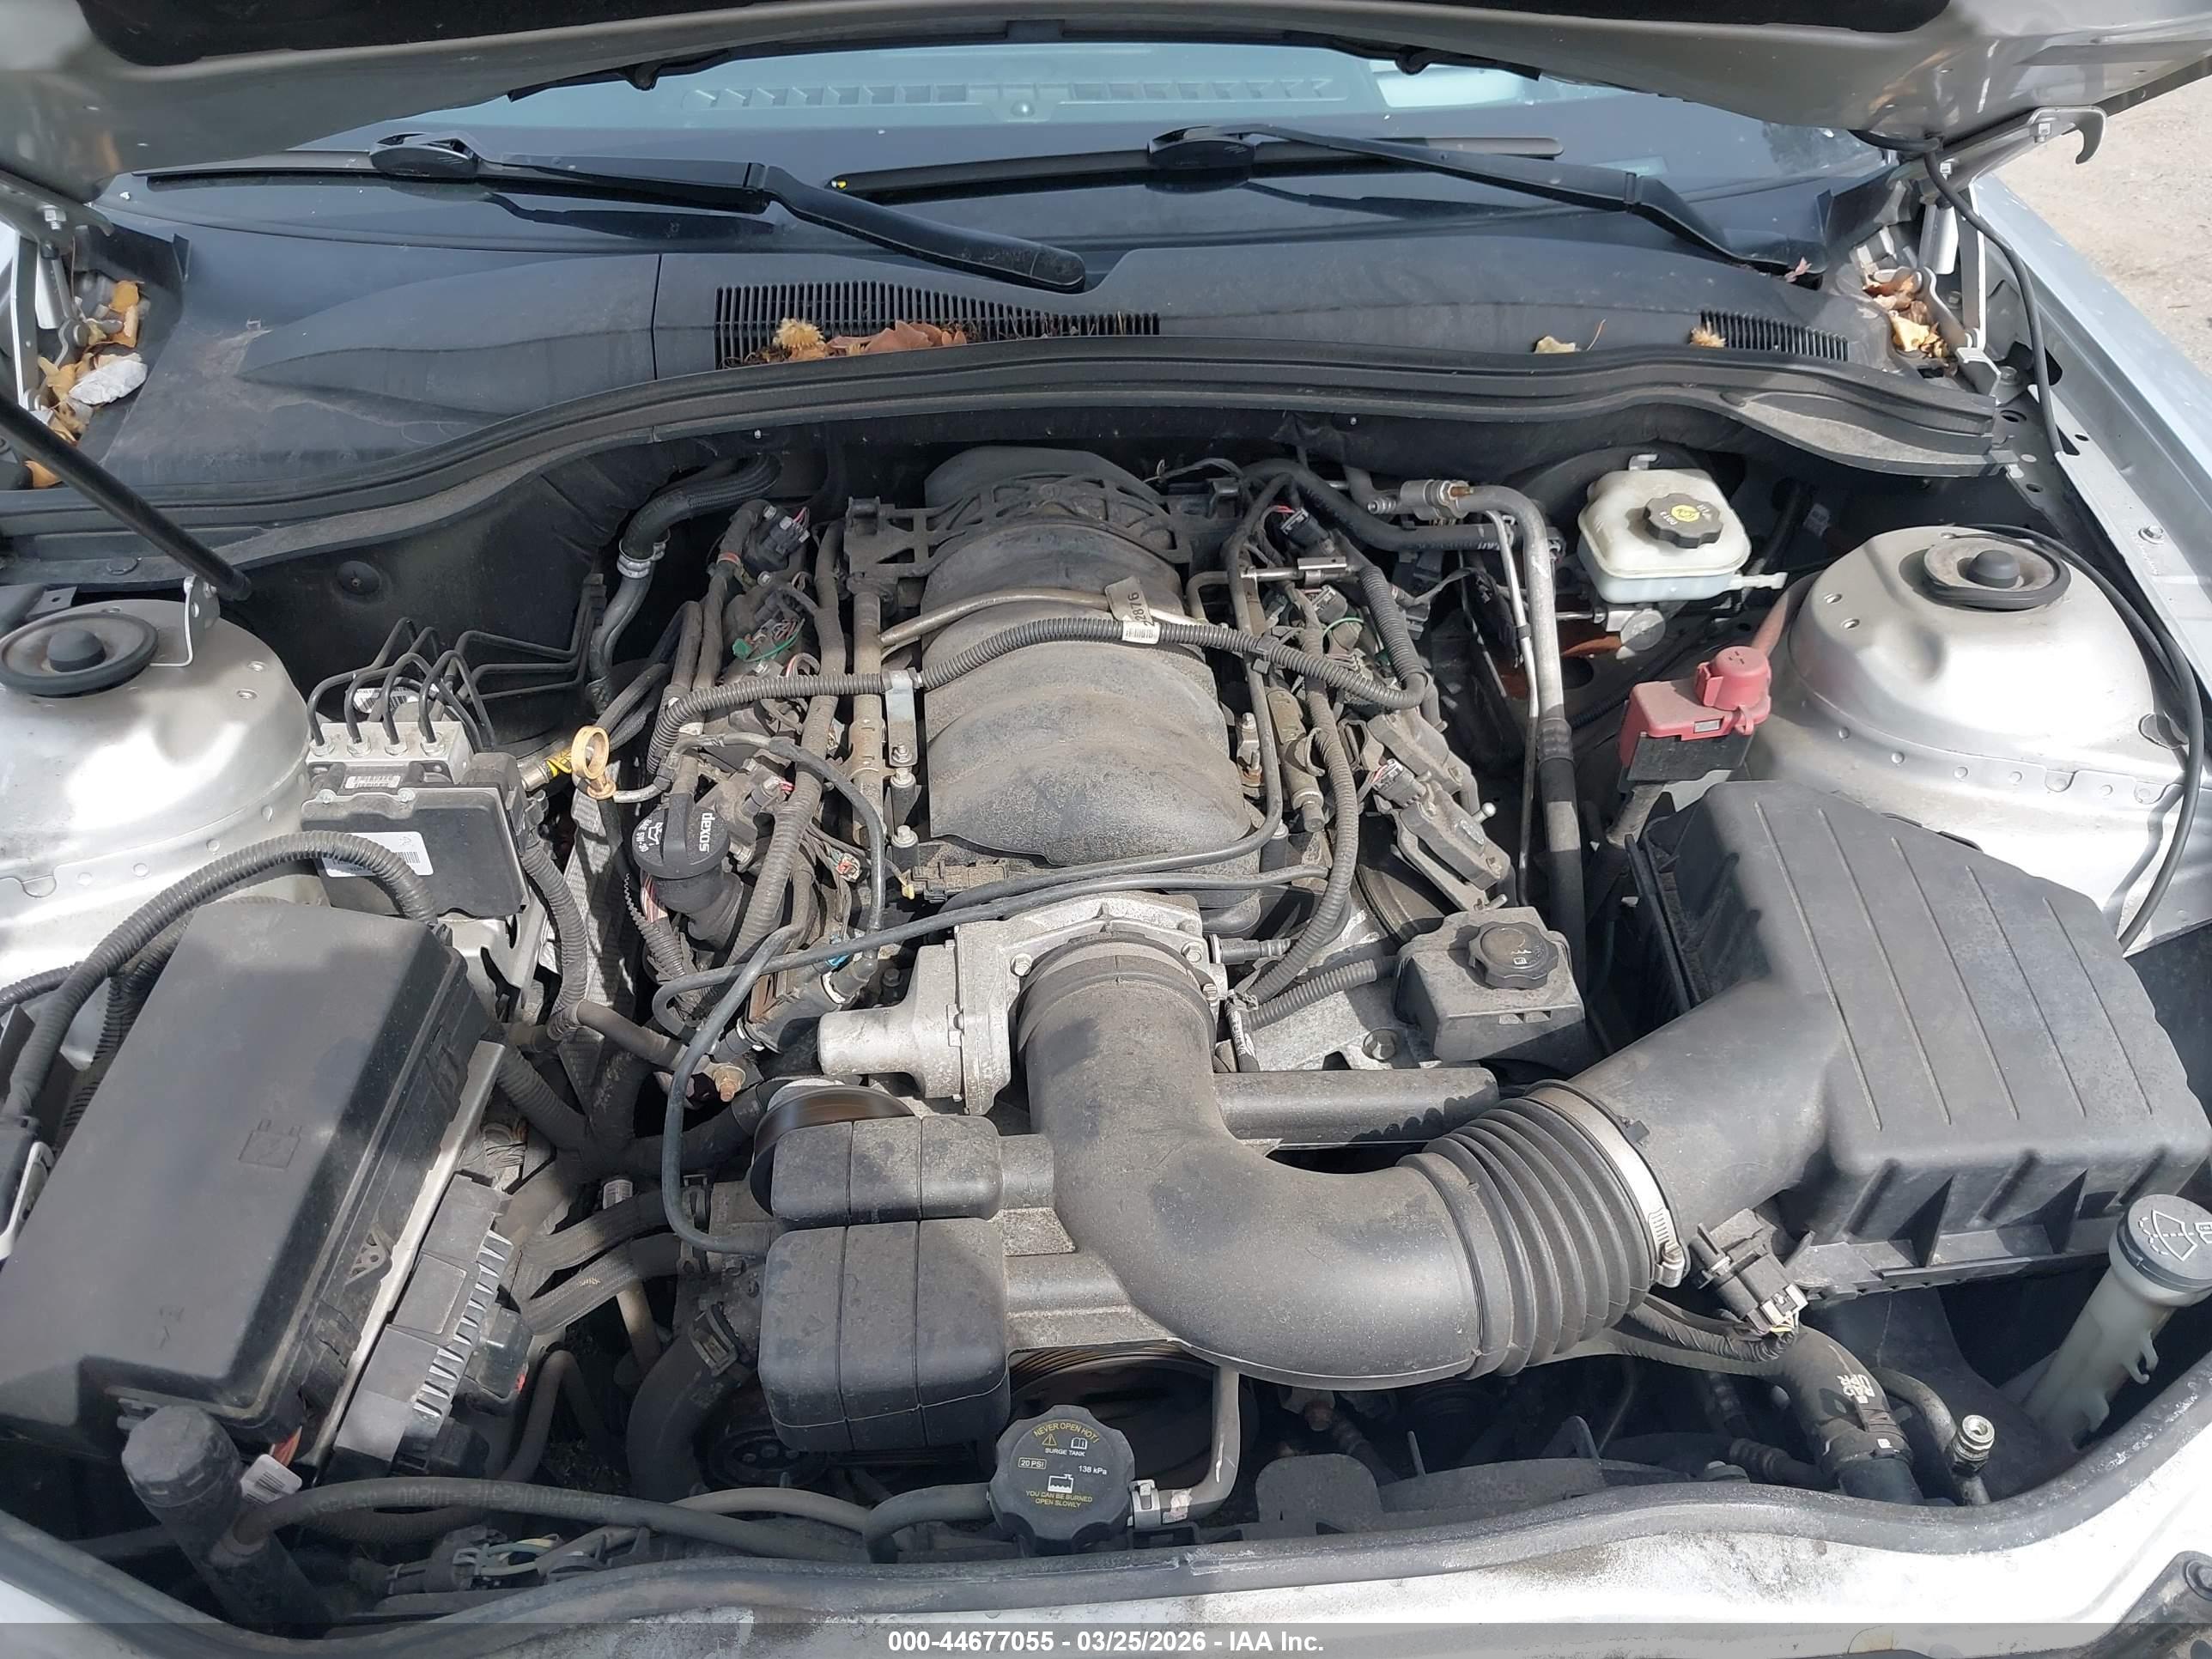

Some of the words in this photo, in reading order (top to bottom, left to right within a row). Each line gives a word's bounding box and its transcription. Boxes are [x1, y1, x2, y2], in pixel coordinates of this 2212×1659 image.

[699, 812, 716, 854] dexos
[1033, 1422, 1059, 1437] NEVER
[1060, 1422, 1081, 1432] OPEN
[1044, 1447, 1067, 1455] SURGE
[1031, 1460, 1044, 1468] PSI
[1078, 1465, 1092, 1474] 138
[1092, 1466, 1108, 1475] kPa
[1066, 1493, 1093, 1503] BURNED
[1054, 1500, 1082, 1509] SLOWLY
